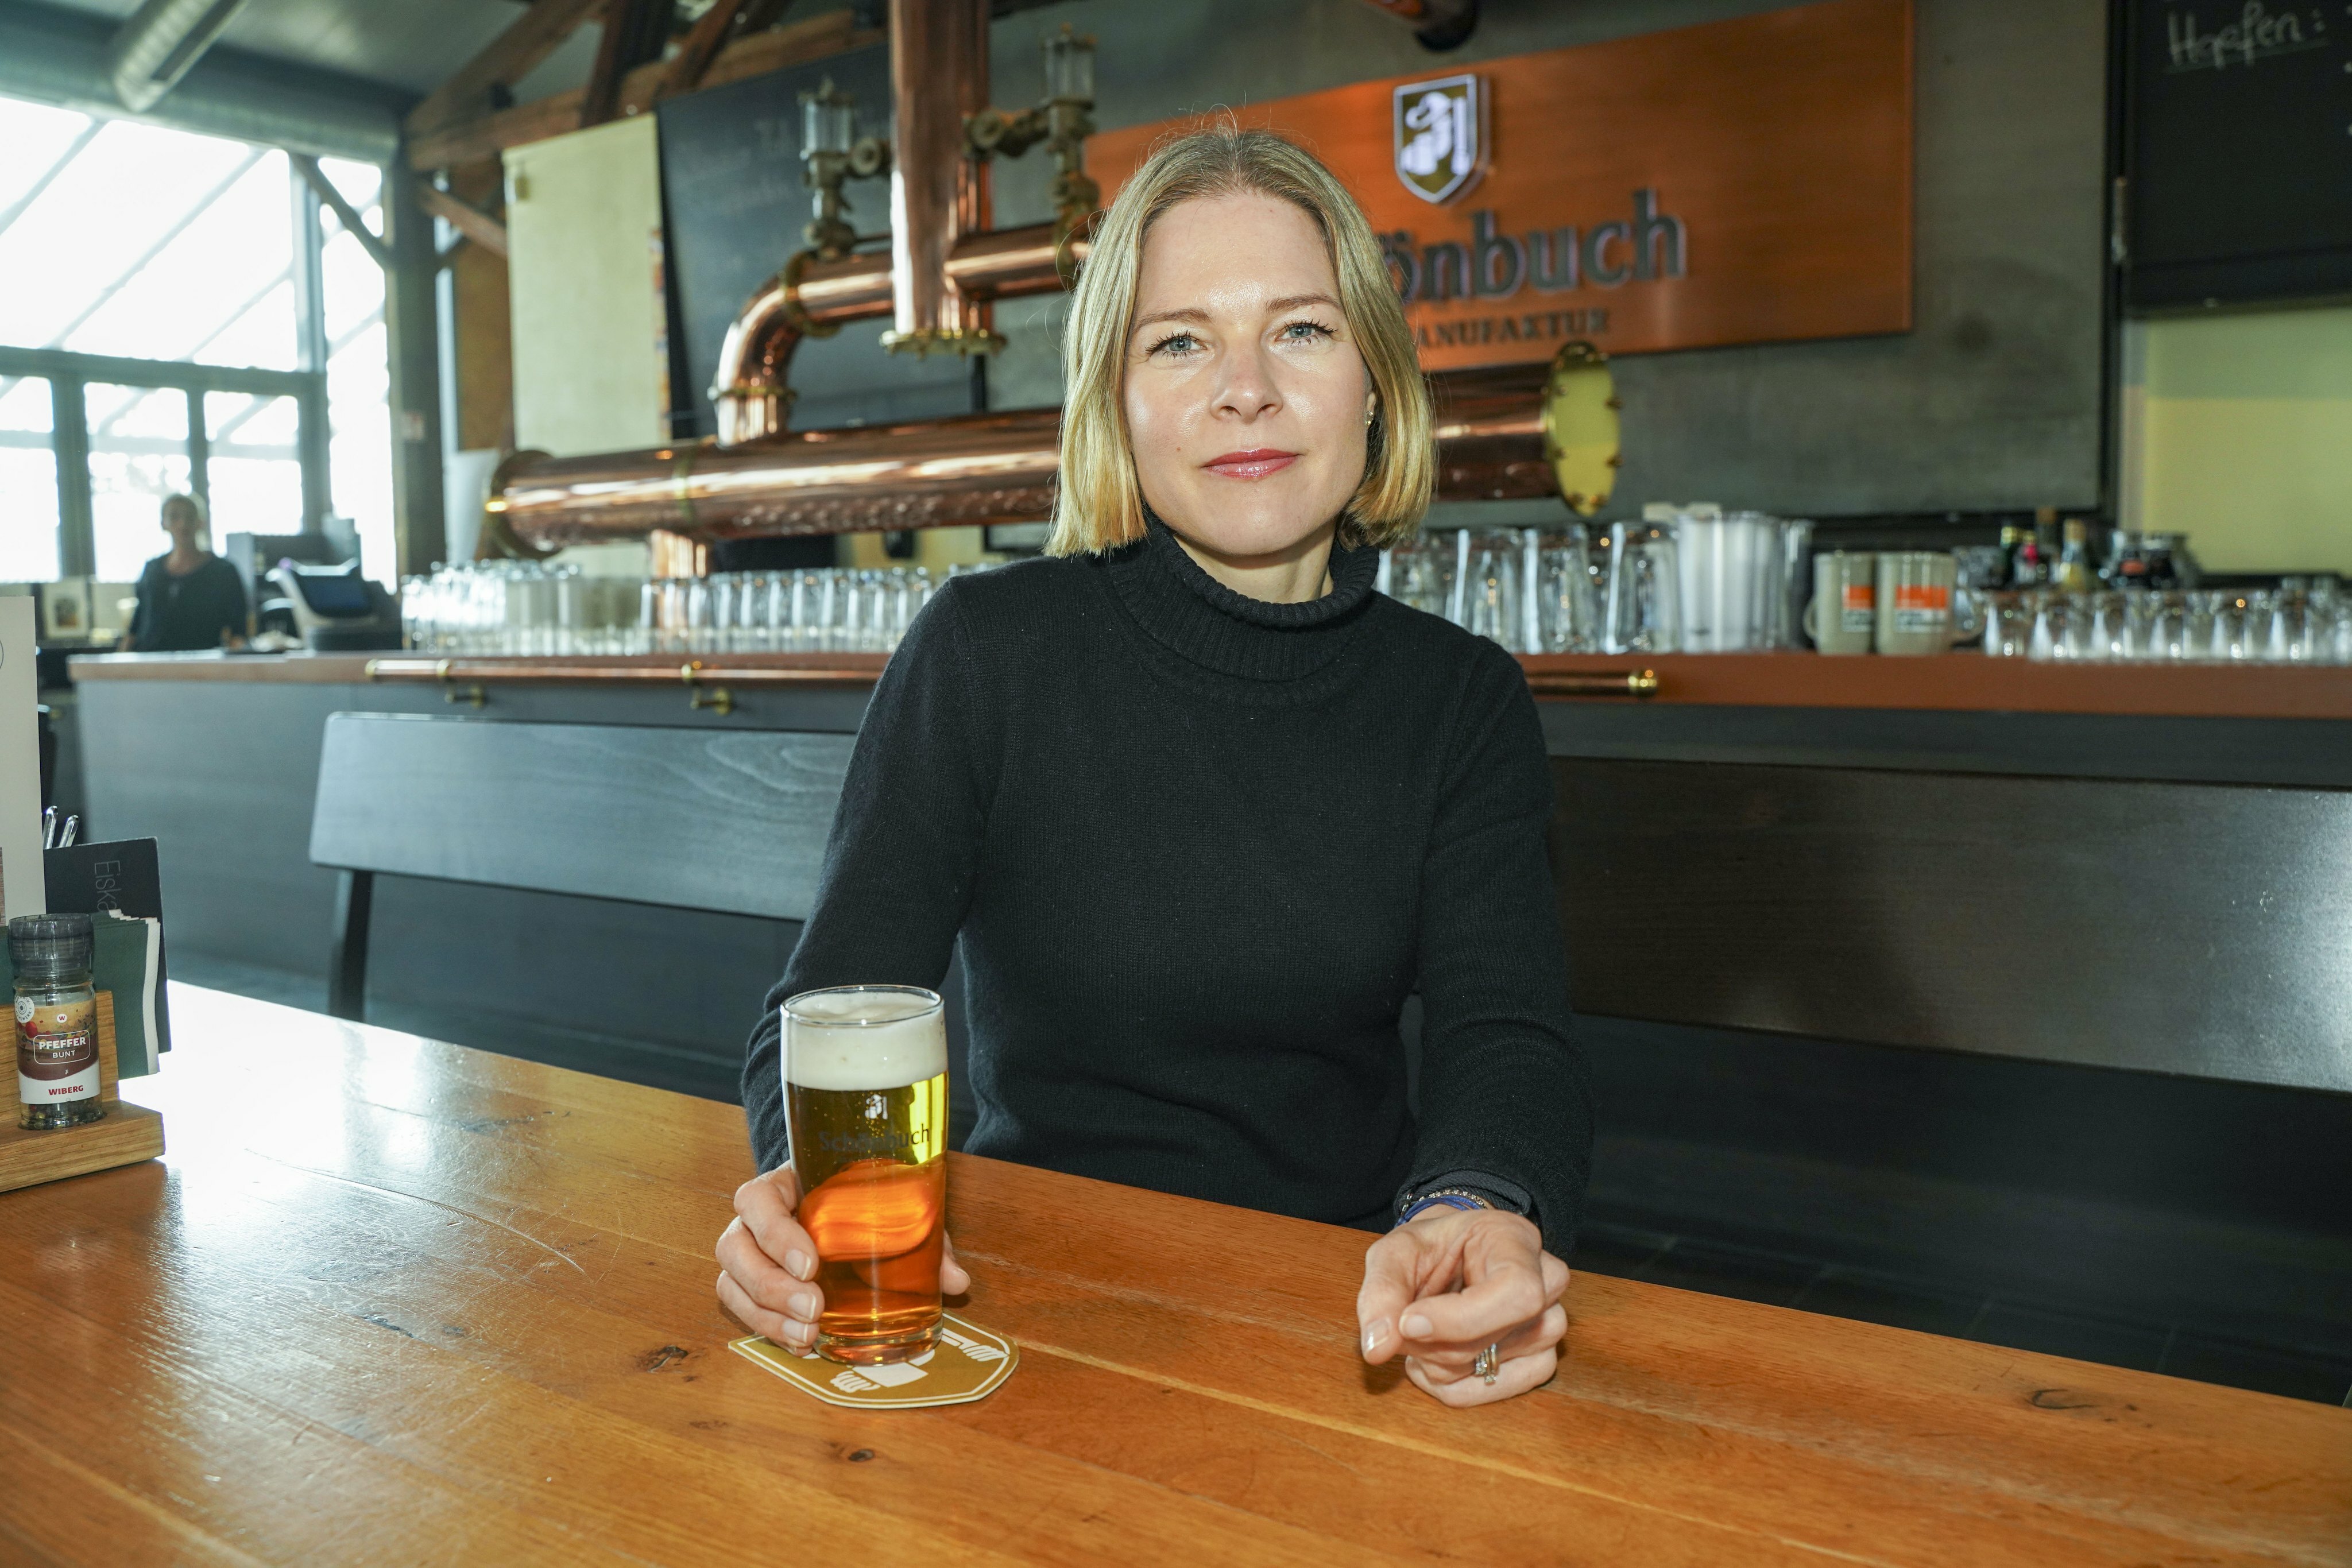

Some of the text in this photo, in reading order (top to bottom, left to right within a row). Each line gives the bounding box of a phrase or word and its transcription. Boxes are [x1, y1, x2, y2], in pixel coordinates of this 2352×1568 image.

[1375, 188, 1686, 304] önbuch
[1417, 308, 1608, 348] ANUFAKTUR
[95, 860, 121, 912] Eiska
[38, 1037, 86, 1050] PFEFFER
[52, 1050, 76, 1058] BUNT
[48, 1085, 84, 1095] WIBERG
